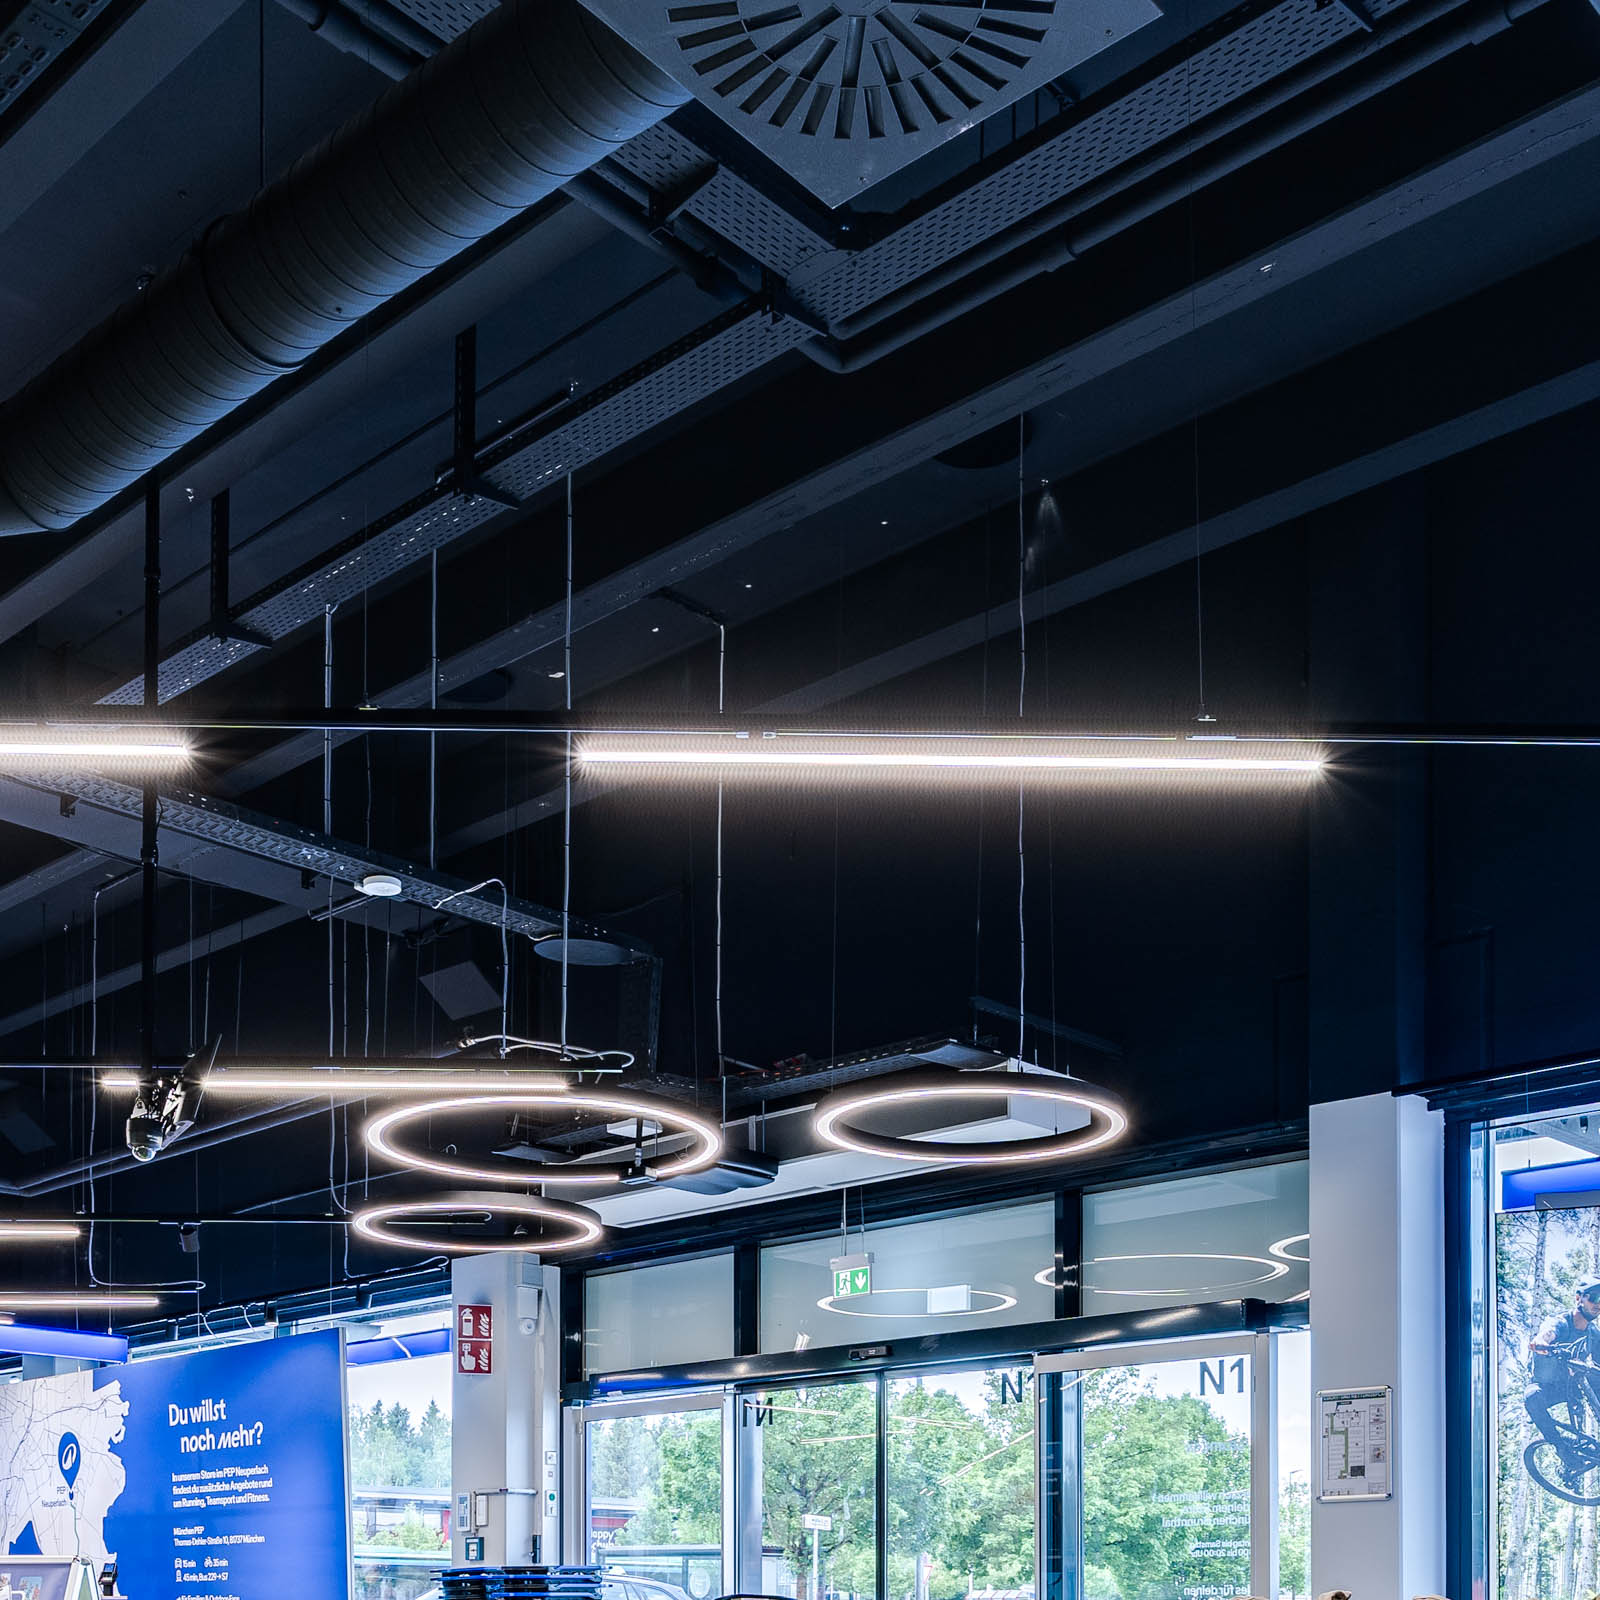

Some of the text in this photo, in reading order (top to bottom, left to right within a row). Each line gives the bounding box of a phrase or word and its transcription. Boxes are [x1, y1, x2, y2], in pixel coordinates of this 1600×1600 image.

[1200, 1357, 1244, 1396] N1
[168, 1398, 227, 1427] Du willst
[180, 1427, 215, 1453] noch
[223, 1467, 236, 1478] PEP
[236, 1464, 269, 1478] Neuperlach
[230, 1479, 259, 1492] Angebote
[259, 1477, 273, 1488] rund
[182, 1497, 206, 1508] Running,
[206, 1495, 236, 1507] Teamsport
[247, 1492, 271, 1503] Fitness.
[591, 1530, 615, 1544] appy
